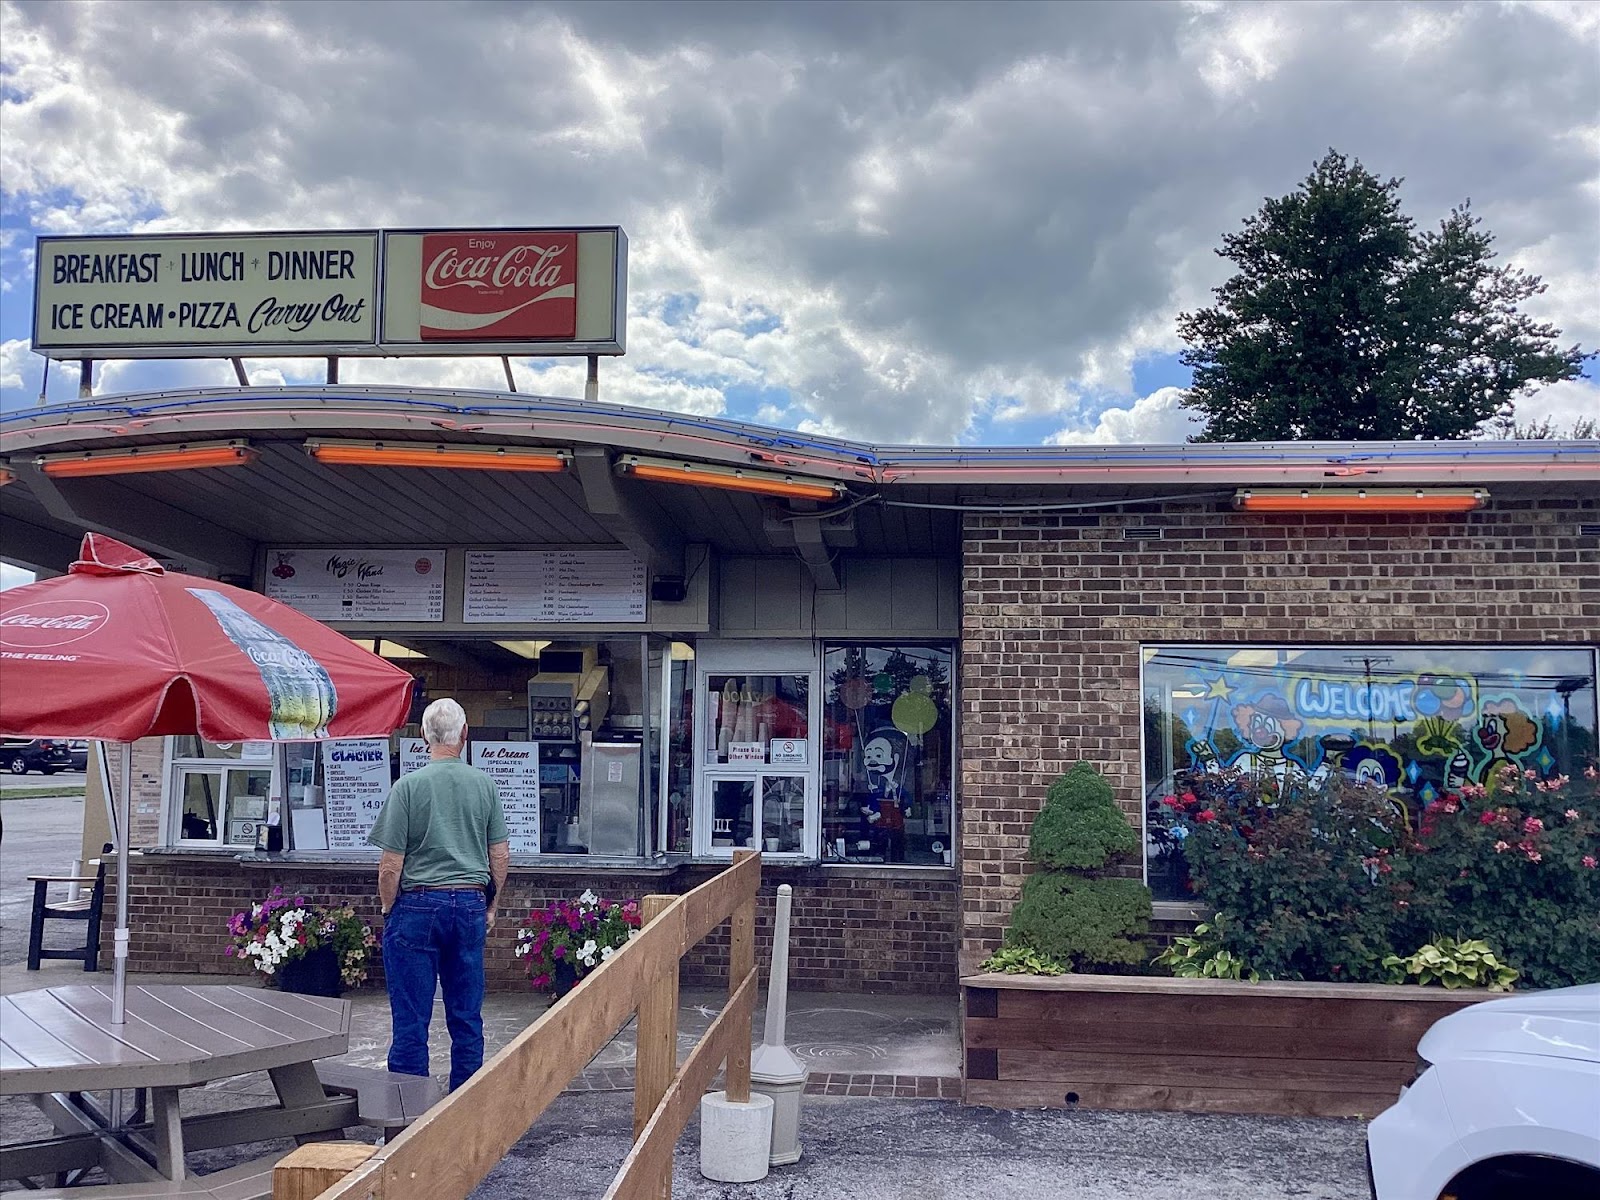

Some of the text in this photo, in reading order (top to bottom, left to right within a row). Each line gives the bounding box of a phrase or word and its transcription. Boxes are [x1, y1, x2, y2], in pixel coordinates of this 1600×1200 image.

[469, 238, 496, 250] Enjoy
[53, 250, 356, 284] BREAKFAST LUNCH DINNER
[425, 244, 568, 290] Coca-Cola
[52, 293, 366, 333] ICE CREAM PIZZA Carry Out
[326, 554, 356, 578] Magic
[358, 562, 385, 581] Wand
[1, 652, 77, 662] THE FEELING
[1298, 678, 1417, 720] WELCOME
[332, 750, 384, 762] GLACIER
[410, 742, 424, 753] Ice
[481, 748, 530, 759] Ice Cream
